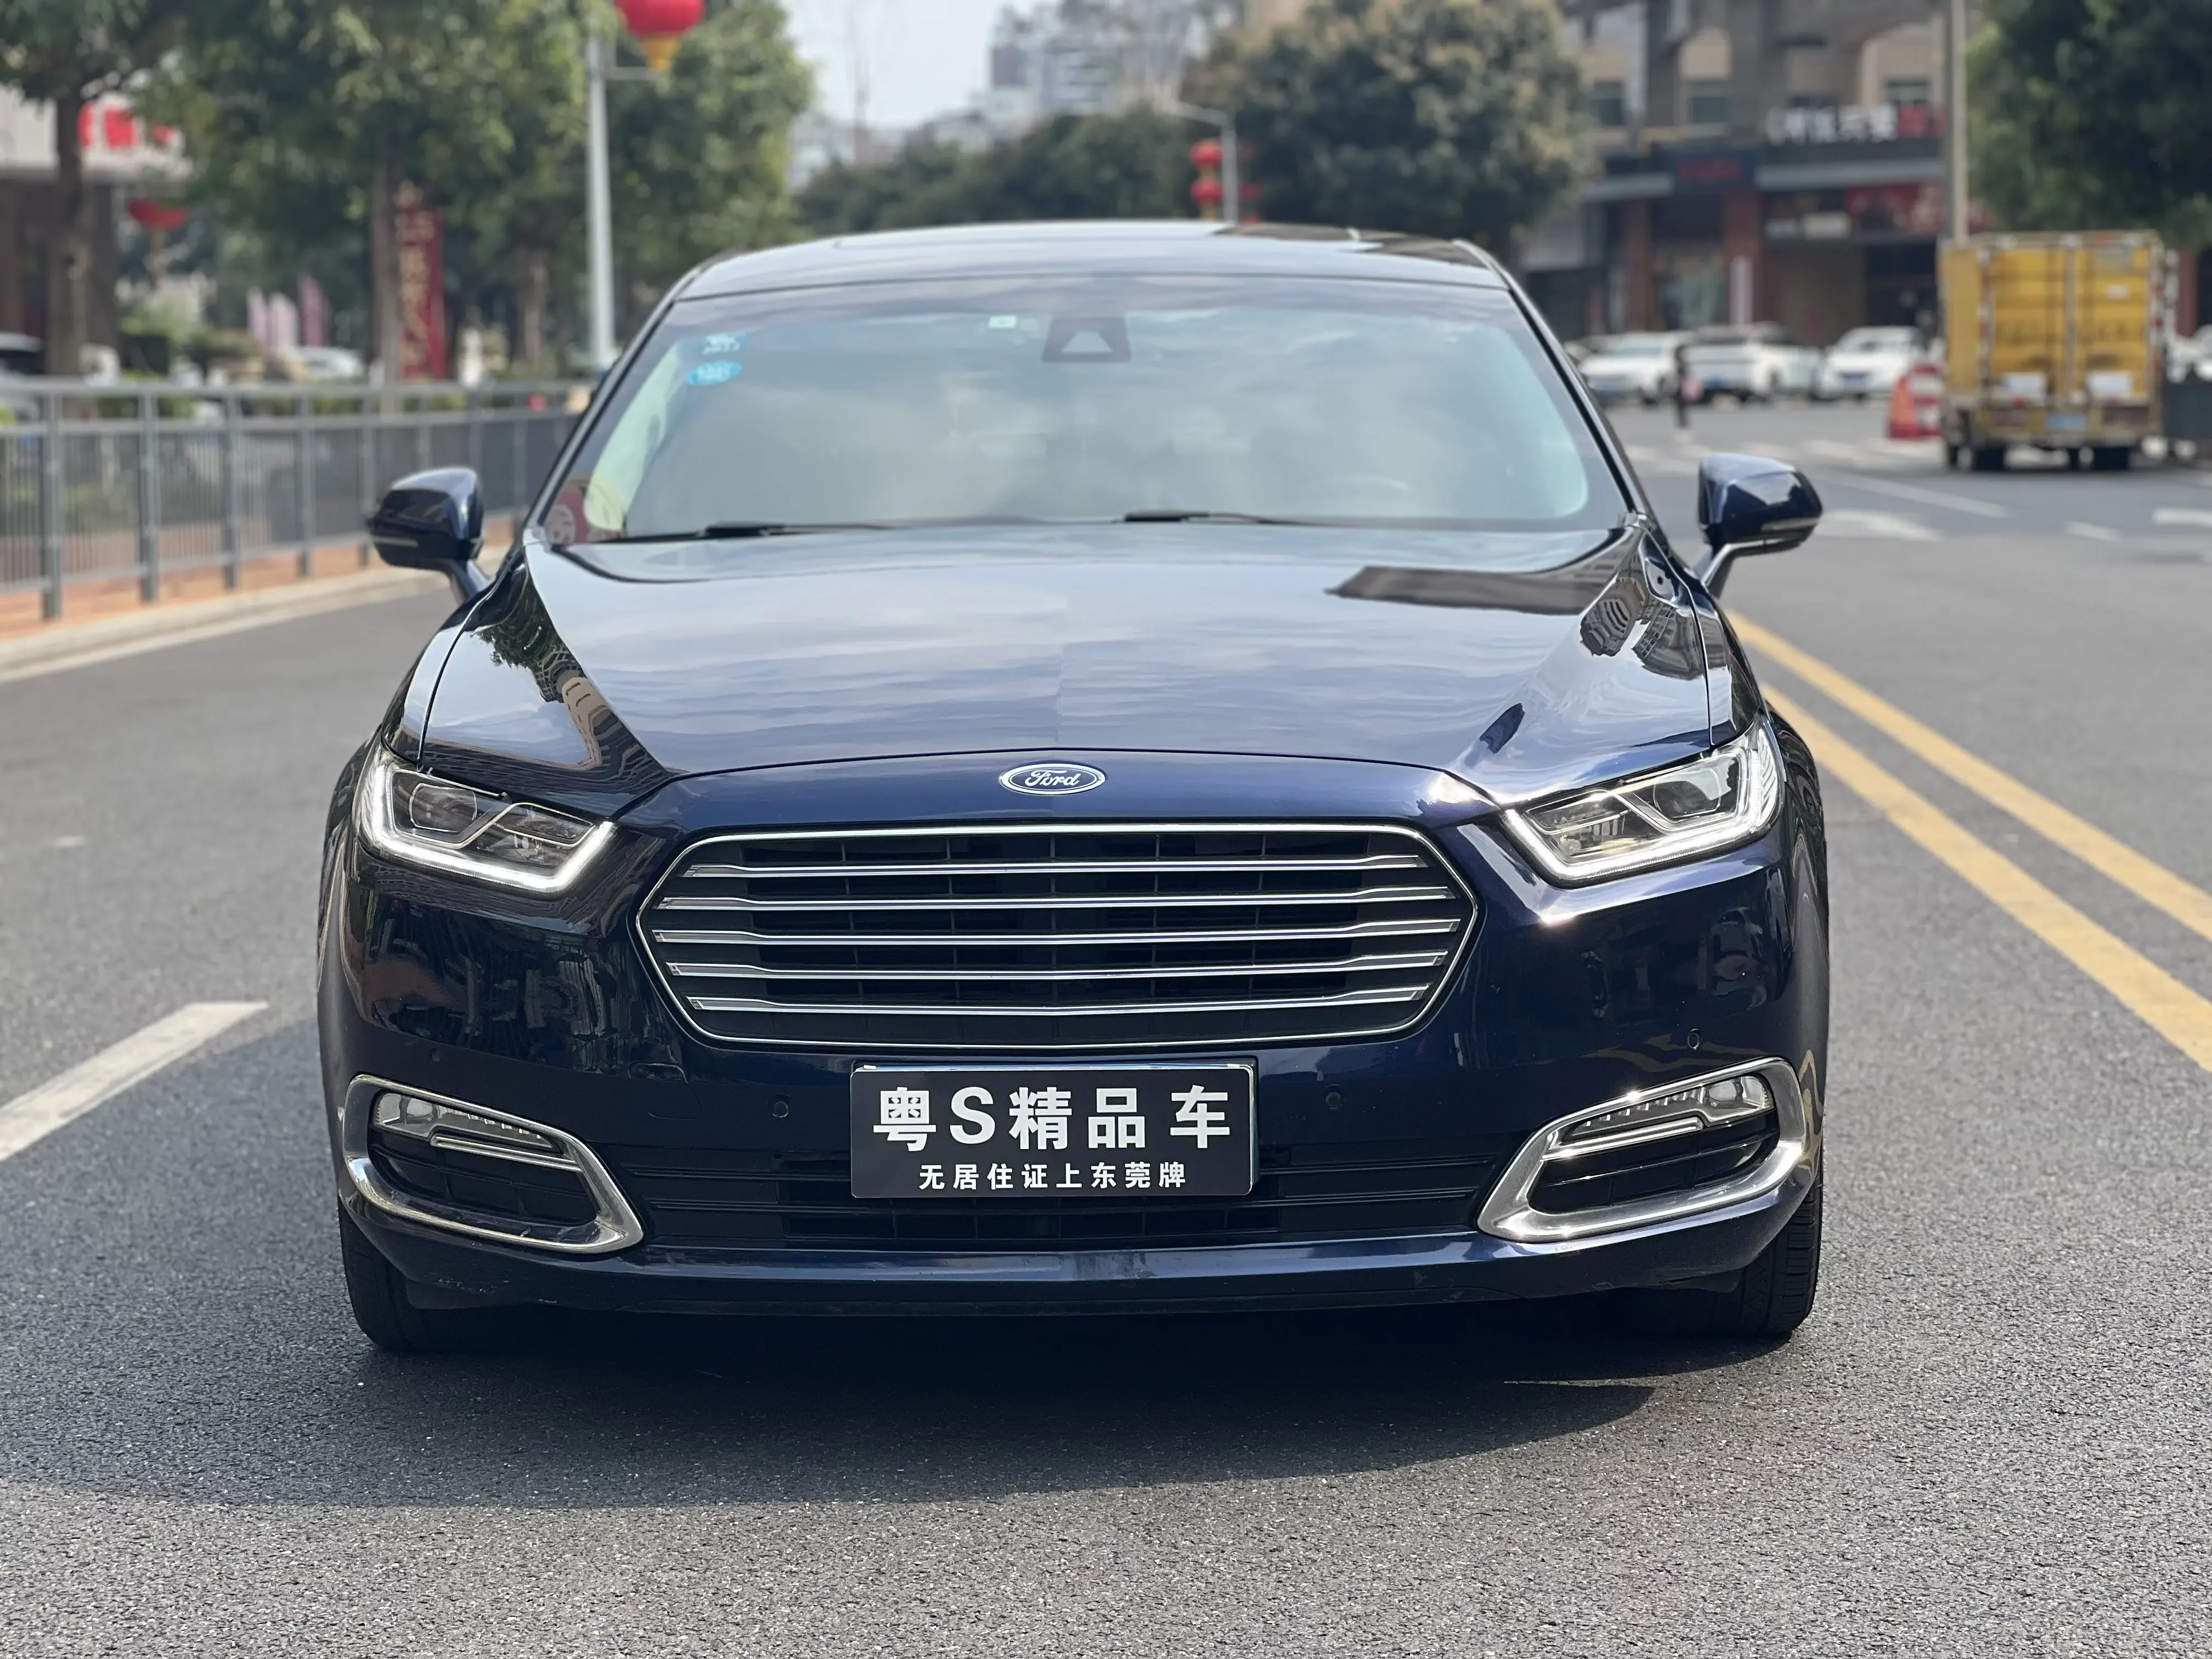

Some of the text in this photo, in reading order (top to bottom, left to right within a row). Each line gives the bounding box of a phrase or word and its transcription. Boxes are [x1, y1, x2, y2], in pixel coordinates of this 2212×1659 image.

[1024, 769, 1082, 787] Ford
[873, 1085, 1230, 1152] 粤S精品车
[919, 1161, 1186, 1190] 无居住证上东莞牌
